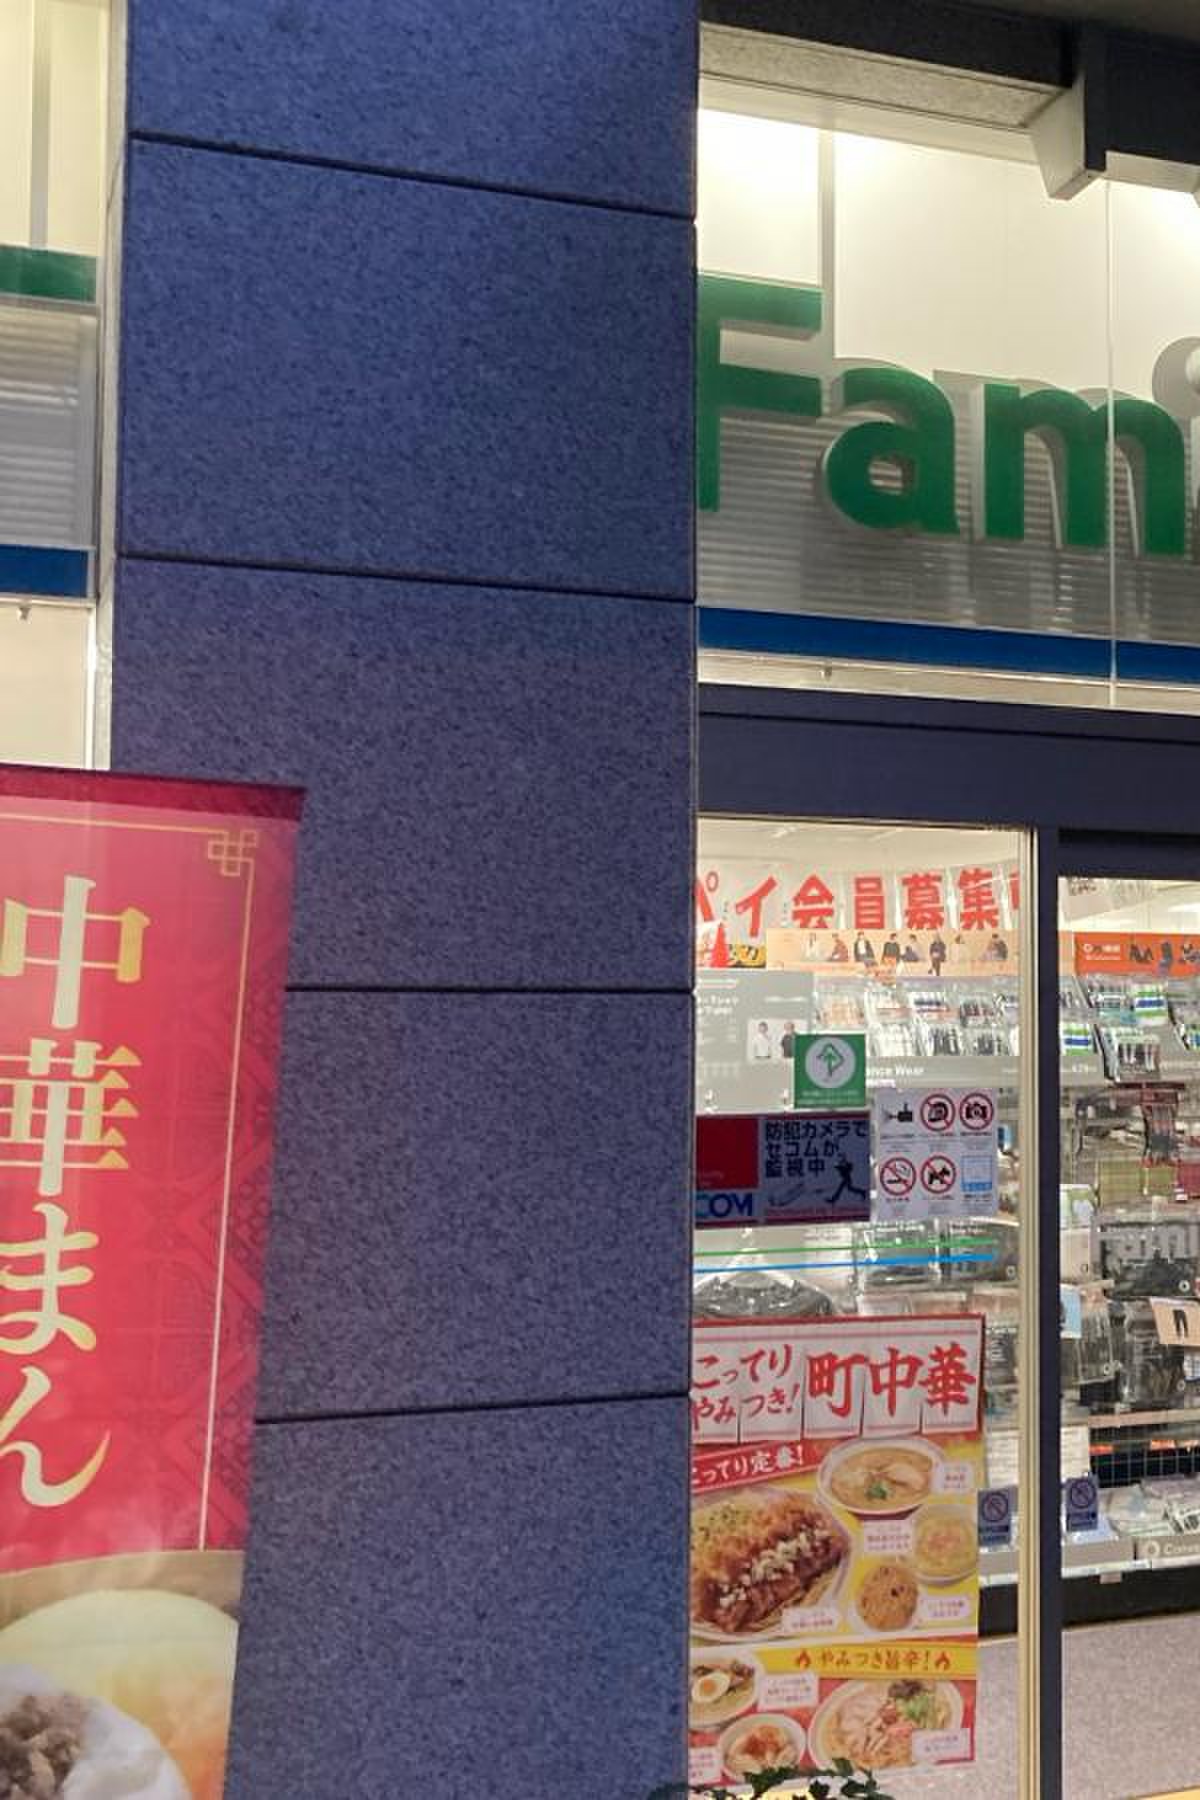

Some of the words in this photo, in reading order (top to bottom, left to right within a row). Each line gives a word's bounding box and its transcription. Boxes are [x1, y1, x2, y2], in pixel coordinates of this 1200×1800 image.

[765, 1119, 868, 1140] 防犯カメラで
[0, 876, 152, 1507] 中華まん
[765, 1157, 825, 1179] 監視中
[806, 1342, 976, 1417] 町中華
